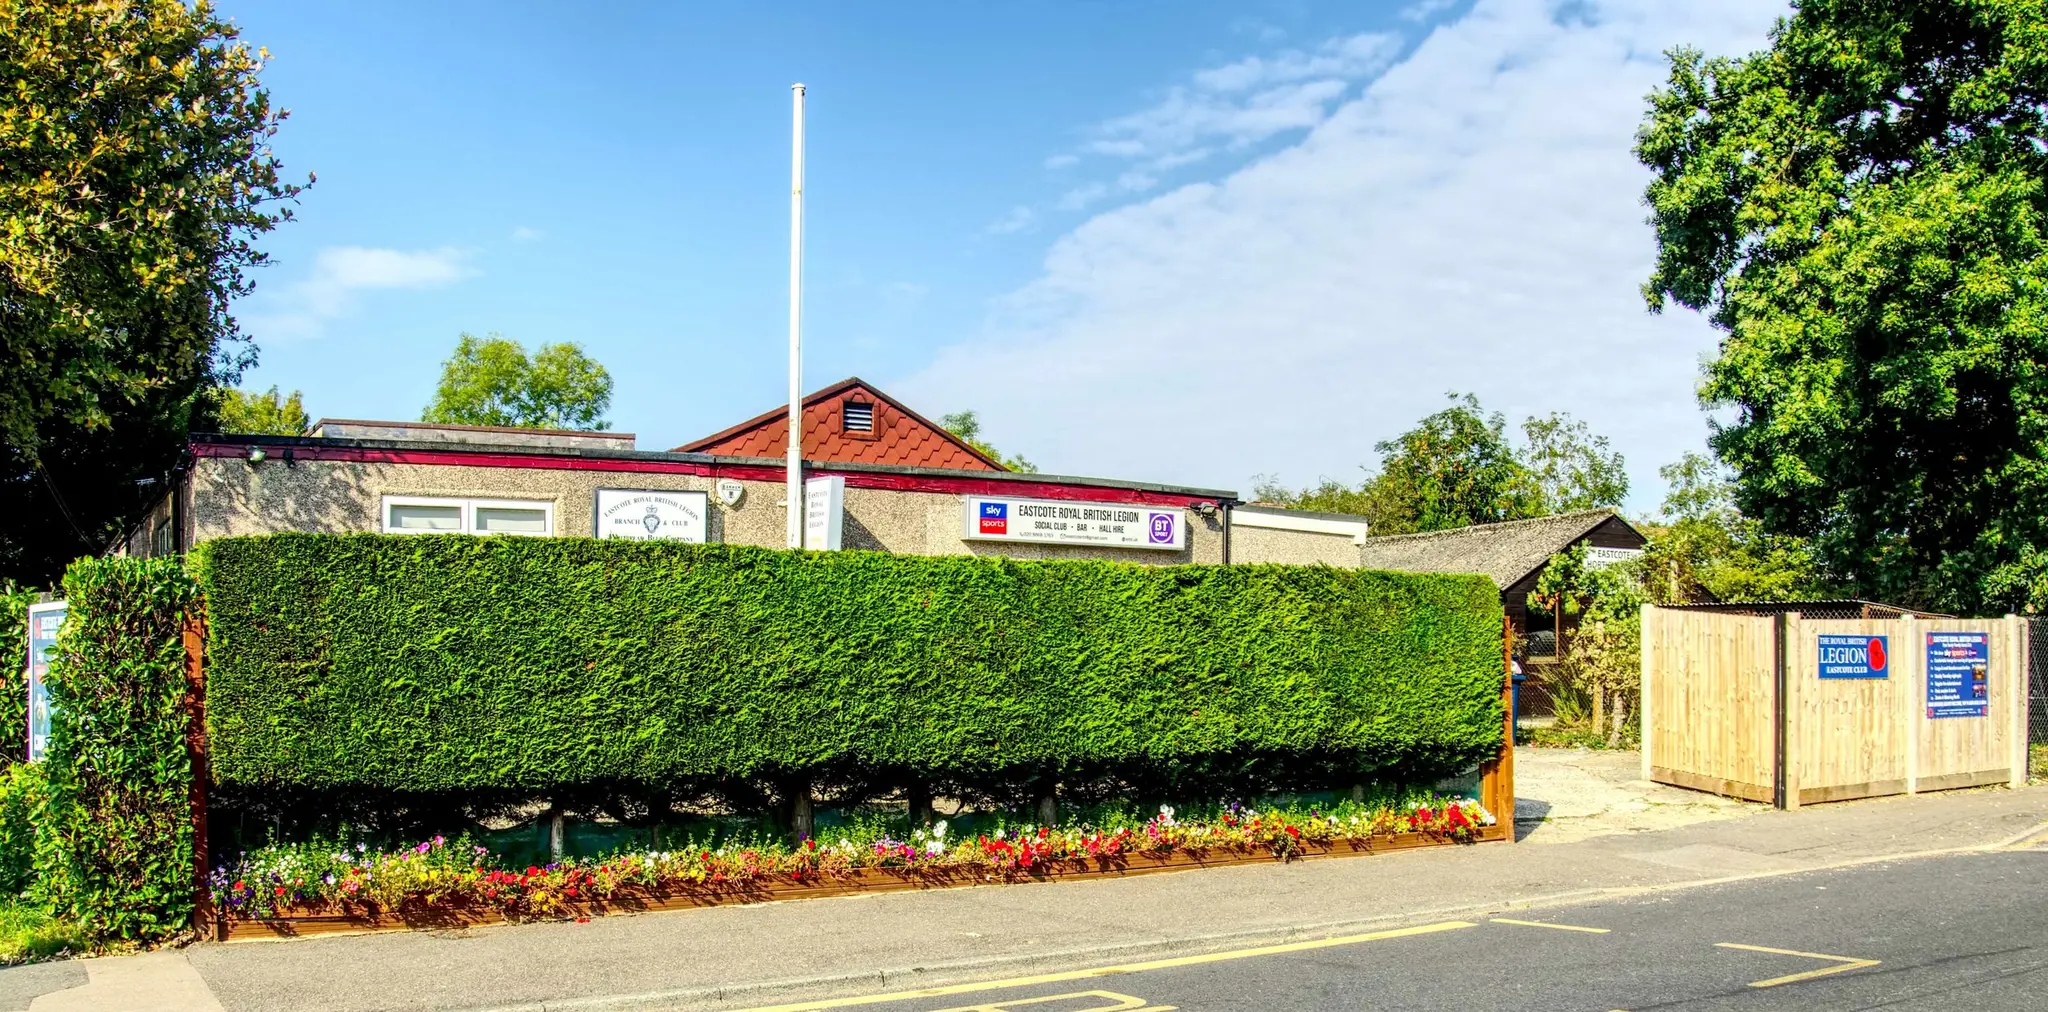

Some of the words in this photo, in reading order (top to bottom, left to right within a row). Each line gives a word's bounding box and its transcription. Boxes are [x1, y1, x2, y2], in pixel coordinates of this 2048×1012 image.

[604, 500, 632, 518] EASTCOTE
[634, 496, 652, 504] ROYAL
[655, 497, 678, 508] BRITISH
[679, 505, 699, 521] LEGION
[985, 505, 1001, 516] sky
[1019, 505, 1056, 518] EASTCOTE
[1058, 507, 1082, 520] ROYAL
[1083, 509, 1112, 522] BRITISH
[1113, 511, 1139, 523] LEGION
[1034, 521, 1052, 530] SOCIAL
[1053, 522, 1067, 531] CLUB
[1076, 523, 1087, 531] BAR
[1099, 525, 1111, 533] HALL
[1112, 525, 1125, 534] HIRE
[1154, 519, 1169, 531] BT
[1597, 549, 1630, 559] EASTCOTE
[1820, 637, 1831, 645] THE
[1831, 637, 1847, 645] ROYAL
[1847, 637, 1867, 645] BRITISH
[1819, 647, 1867, 664] LEGION
